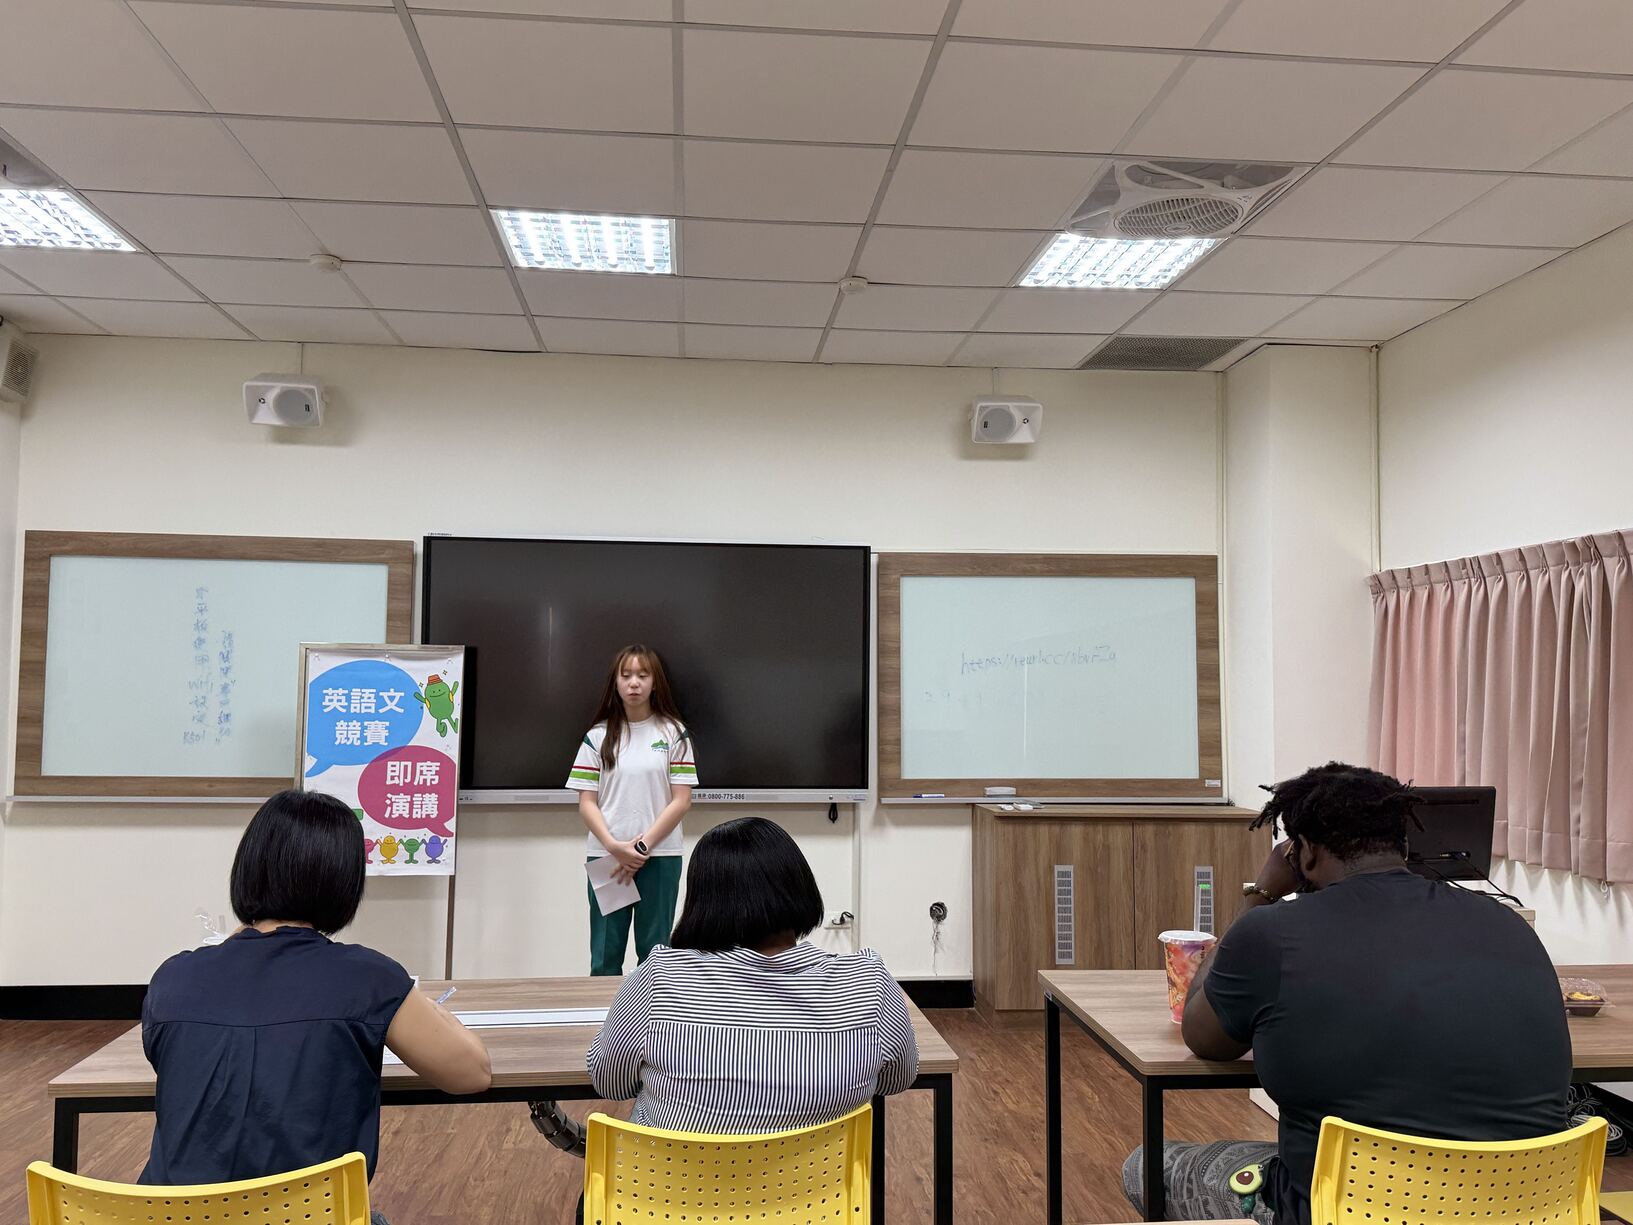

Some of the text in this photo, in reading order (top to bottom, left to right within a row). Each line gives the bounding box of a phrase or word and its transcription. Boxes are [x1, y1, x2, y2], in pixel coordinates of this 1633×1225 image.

[322, 688, 405, 714] 英語文
[335, 720, 390, 746] 競賽
[386, 761, 440, 787] 即席
[384, 793, 439, 819] 演講
